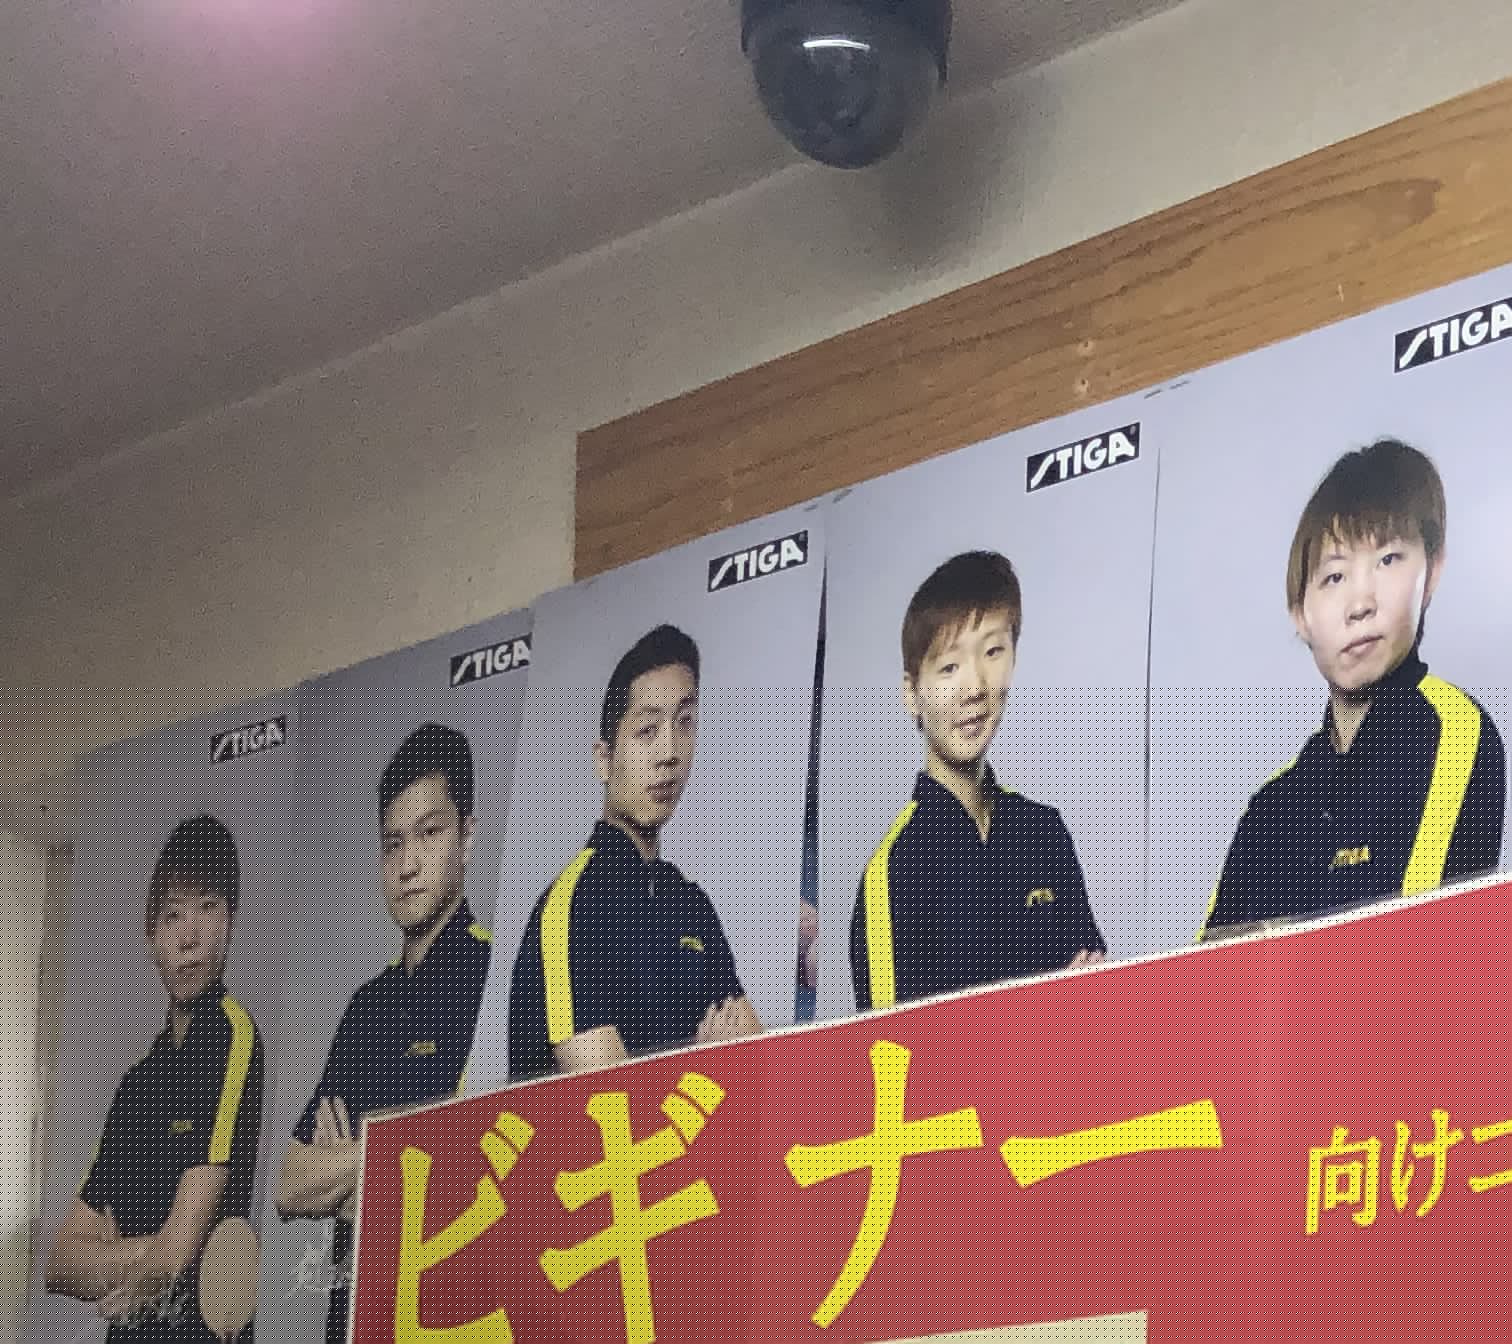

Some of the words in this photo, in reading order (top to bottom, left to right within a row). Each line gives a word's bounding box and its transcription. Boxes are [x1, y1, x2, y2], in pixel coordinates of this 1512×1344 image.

[1029, 430, 1137, 490] STIGA
[709, 535, 807, 590] STIGA
[450, 634, 531, 686] STIGA
[211, 717, 286, 762] STIGA
